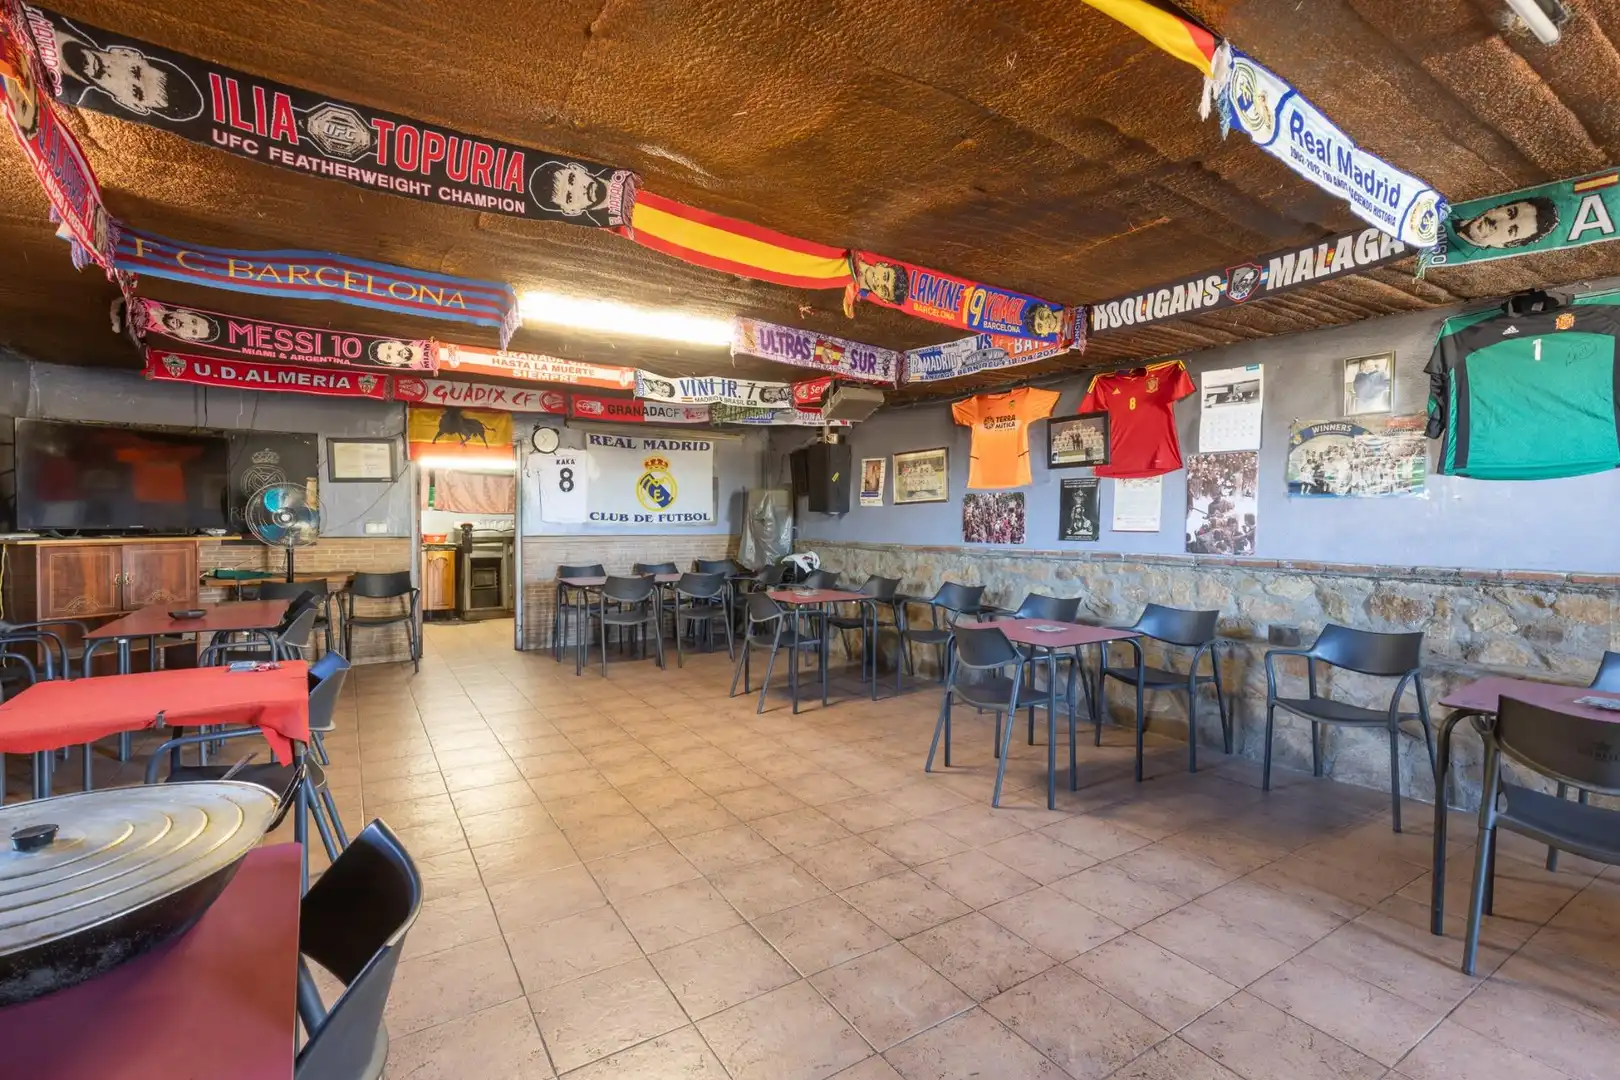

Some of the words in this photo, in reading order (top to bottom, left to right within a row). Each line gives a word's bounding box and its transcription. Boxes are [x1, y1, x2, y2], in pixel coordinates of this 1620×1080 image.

[209, 72, 299, 145] ILIA
[371, 118, 524, 193] TOPURIA
[324, 122, 357, 141] UFC
[1290, 109, 1332, 167] Real
[1337, 146, 1400, 209] Madrid
[212, 128, 259, 155] UFC
[269, 147, 432, 197] FEATHERWEIGHT
[439, 186, 526, 214] CHAMPION
[1567, 193, 1615, 242] A
[228, 258, 466, 309] BARCELONA
[1092, 275, 1223, 332] HOOLIGANS
[1266, 227, 1405, 290] MALAGA
[909, 270, 964, 312] LAMINE
[962, 284, 985, 326] 19
[984, 291, 1027, 326] YAMAL
[913, 302, 955, 322] BARCELONA
[983, 320, 1021, 333] BARCELONA
[228, 320, 322, 355] MESSI
[330, 334, 362, 359] 10
[975, 333, 992, 350] VS
[1532, 338, 1542, 360] 1
[241, 347, 276, 358] MIAMI
[279, 351, 287, 359] &
[290, 353, 350, 365] ARGENTINA
[423, 343, 431, 369] MIAM
[760, 328, 811, 360] ULTRAS
[850, 349, 877, 374] SUR
[492, 358, 531, 370] HASTA
[534, 361, 549, 371] LA
[552, 365, 596, 376] MUERTE
[921, 352, 957, 372] MADRID
[512, 369, 579, 383] SIEMPRE
[433, 382, 508, 404] GUADIX
[512, 391, 537, 408] CF
[679, 377, 715, 397] VINI
[719, 379, 742, 399] JR.
[747, 382, 756, 399] 7
[695, 395, 718, 403] MADRID
[1129, 396, 1136, 410] 8
[996, 414, 1016, 424] TERRA
[1311, 422, 1353, 434] WINNERS
[589, 434, 637, 450] REAL
[643, 440, 711, 452] MADRID
[559, 467, 574, 493] 8
[589, 512, 629, 522] CLUB
[634, 514, 655, 523] DE
[658, 512, 711, 523] FUTBOL
